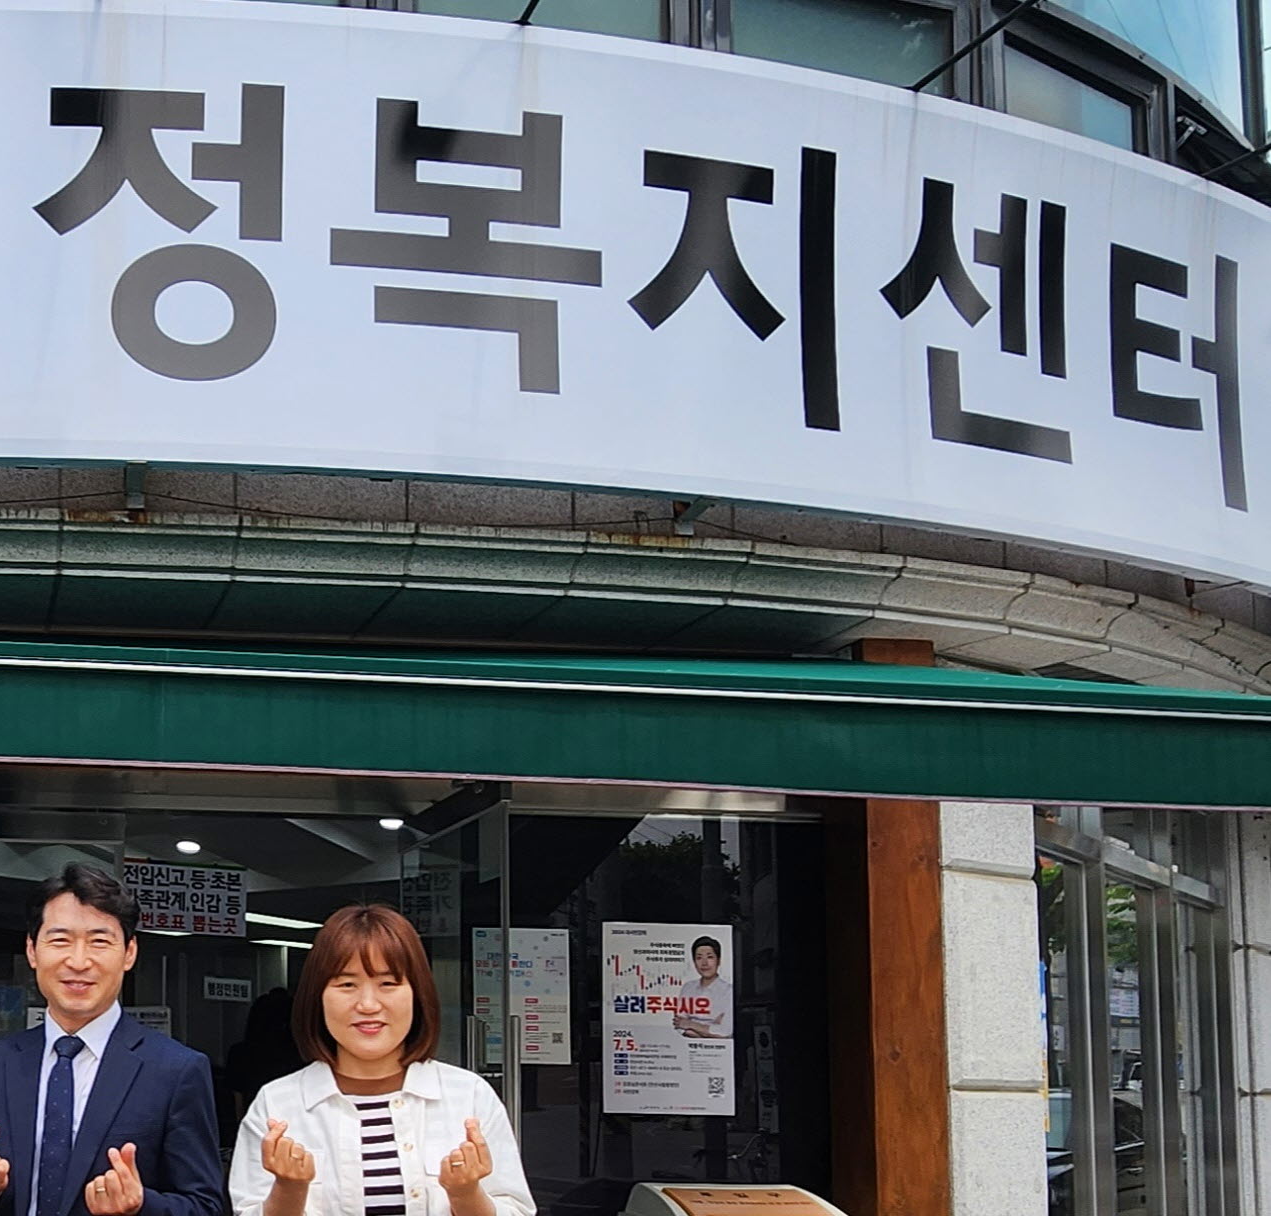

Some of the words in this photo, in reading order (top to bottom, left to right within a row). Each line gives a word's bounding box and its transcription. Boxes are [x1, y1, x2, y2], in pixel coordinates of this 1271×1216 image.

[225, 895, 242, 916] 등
[141, 912, 186, 930] 번호표
[614, 995, 711, 1015] 살려주식시오
